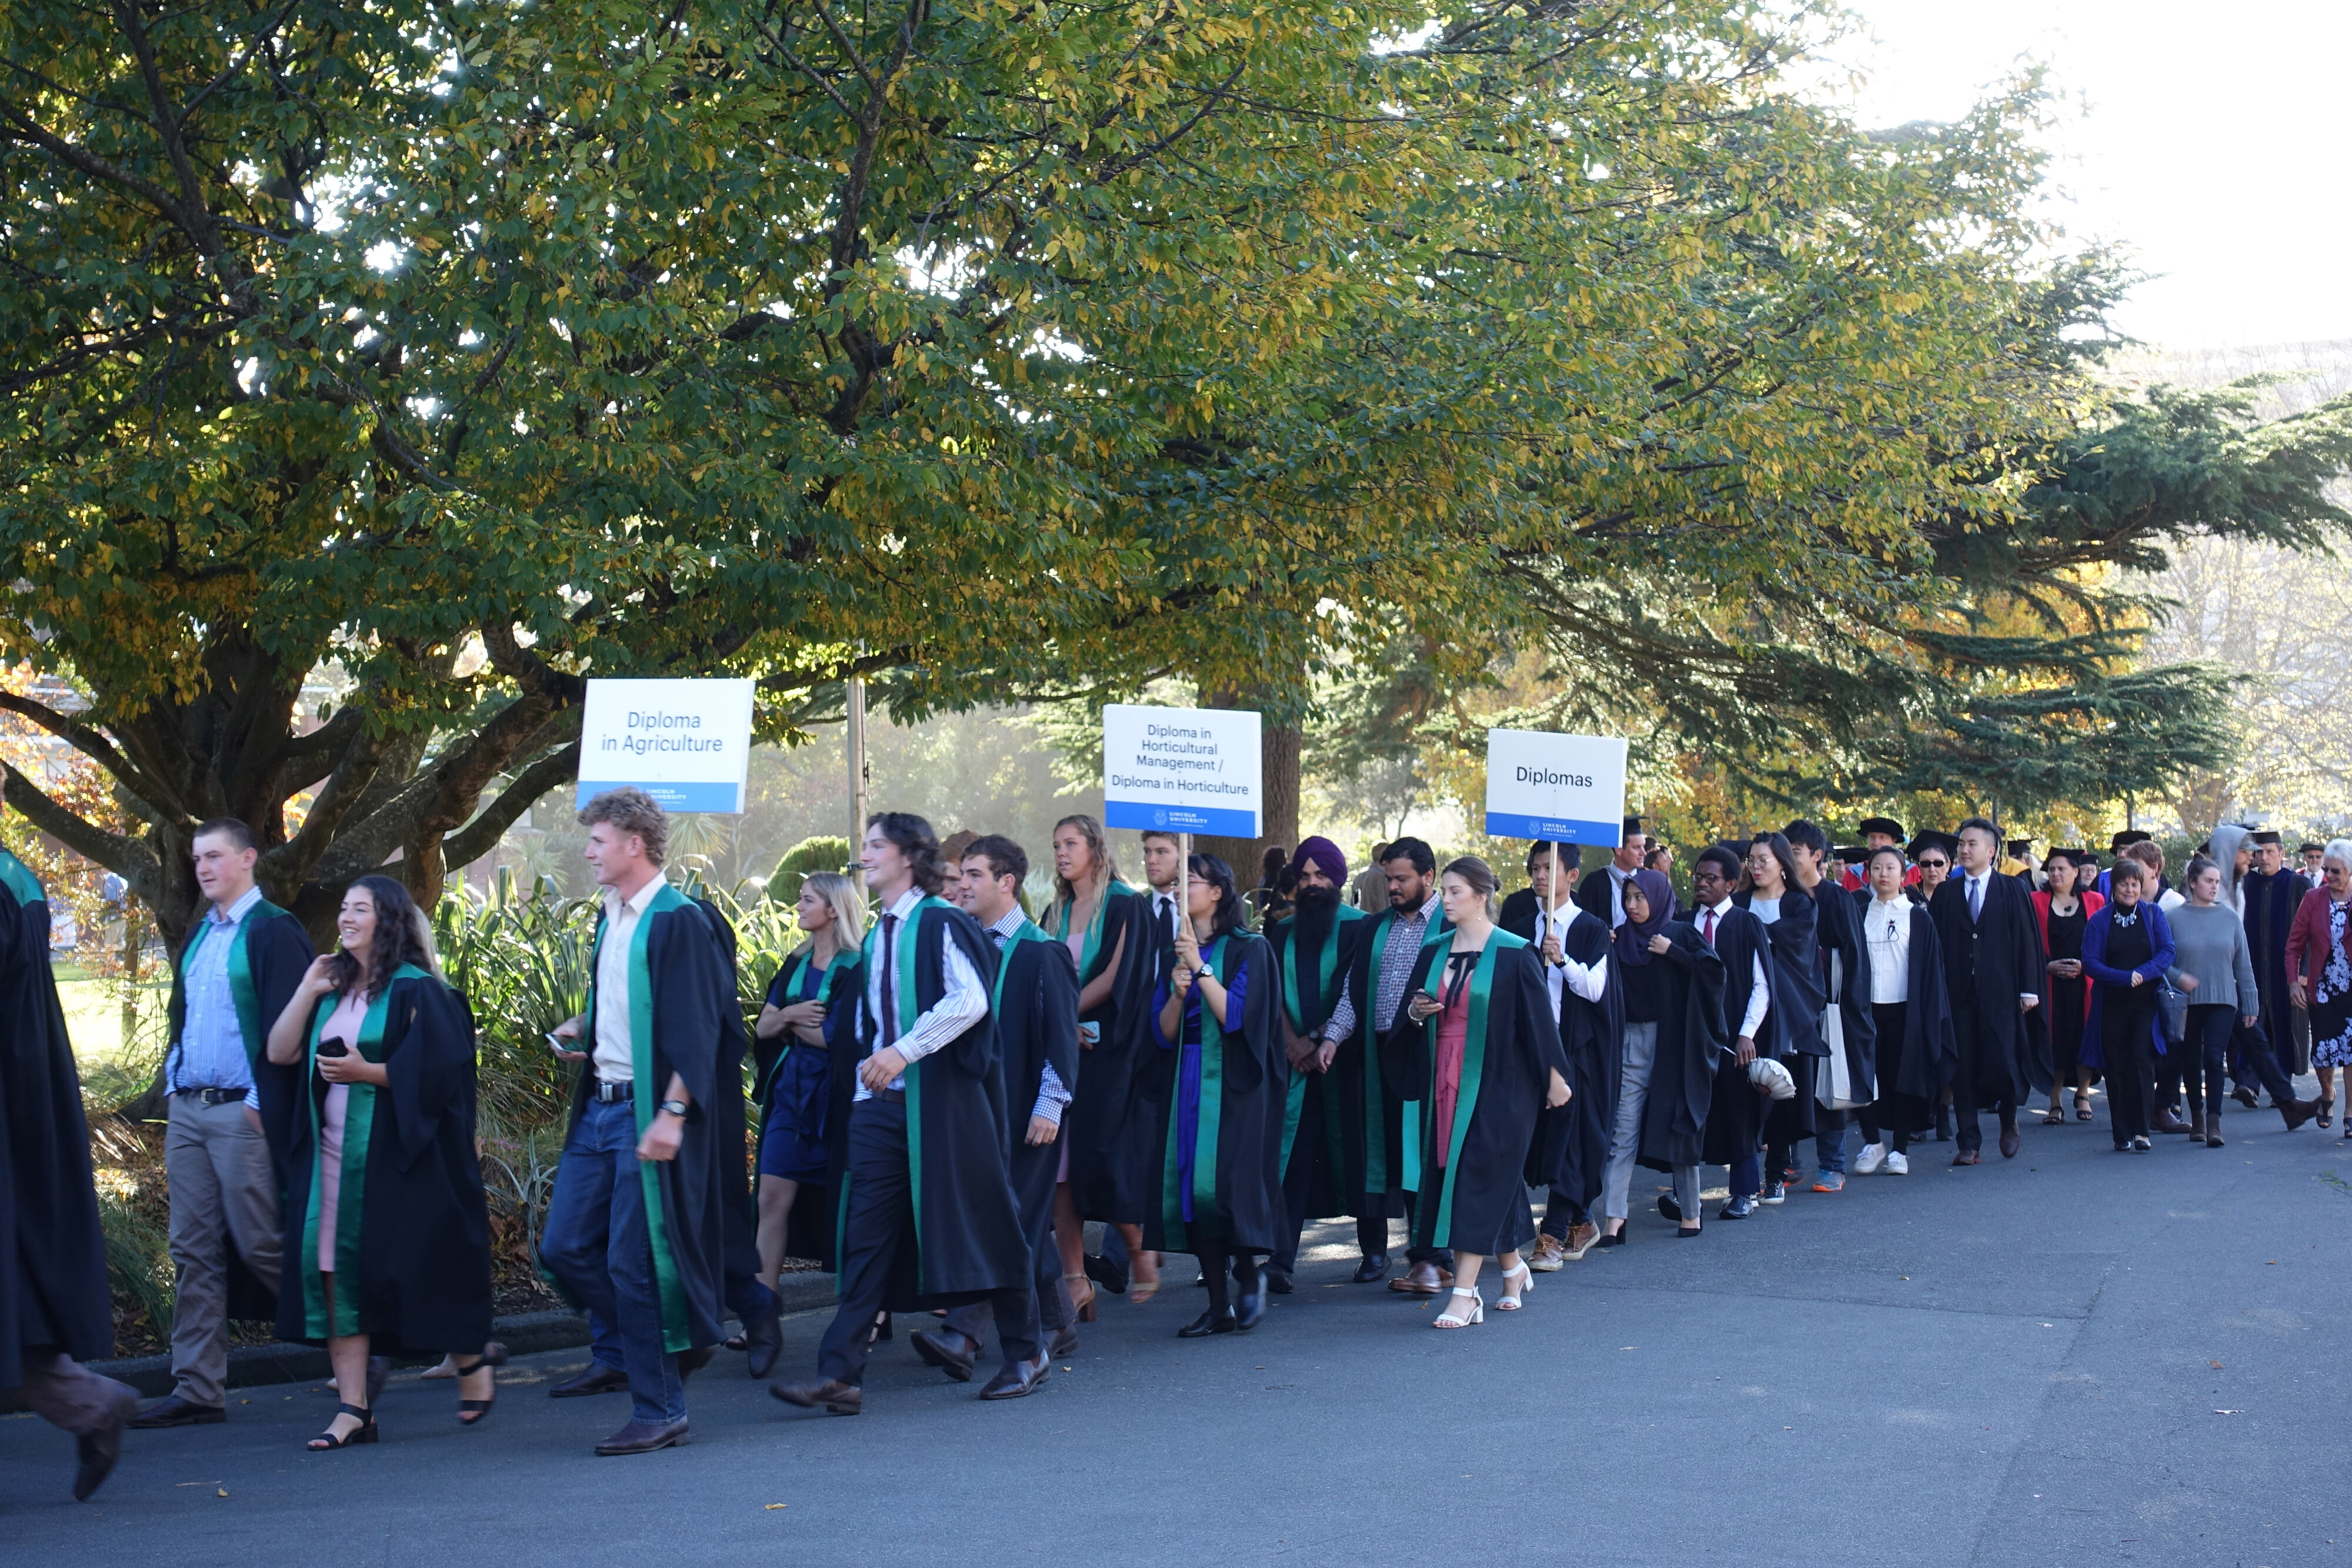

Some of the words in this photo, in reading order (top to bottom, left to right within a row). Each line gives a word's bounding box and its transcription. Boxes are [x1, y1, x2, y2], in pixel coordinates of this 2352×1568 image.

[628, 711, 700, 731] Diploma
[1147, 724, 1197, 738] Diploma
[1200, 727, 1212, 739] in
[601, 735, 617, 751] in
[622, 735, 723, 755] Agriculture
[1142, 740, 1217, 755] Horticultural
[1136, 755, 1215, 770] Management
[1218, 759, 1223, 773] /
[1112, 775, 1160, 789] Diploma
[1164, 778, 1174, 790] in
[1177, 779, 1249, 795] Horticulture
[1517, 766, 1593, 787] Diplomas
